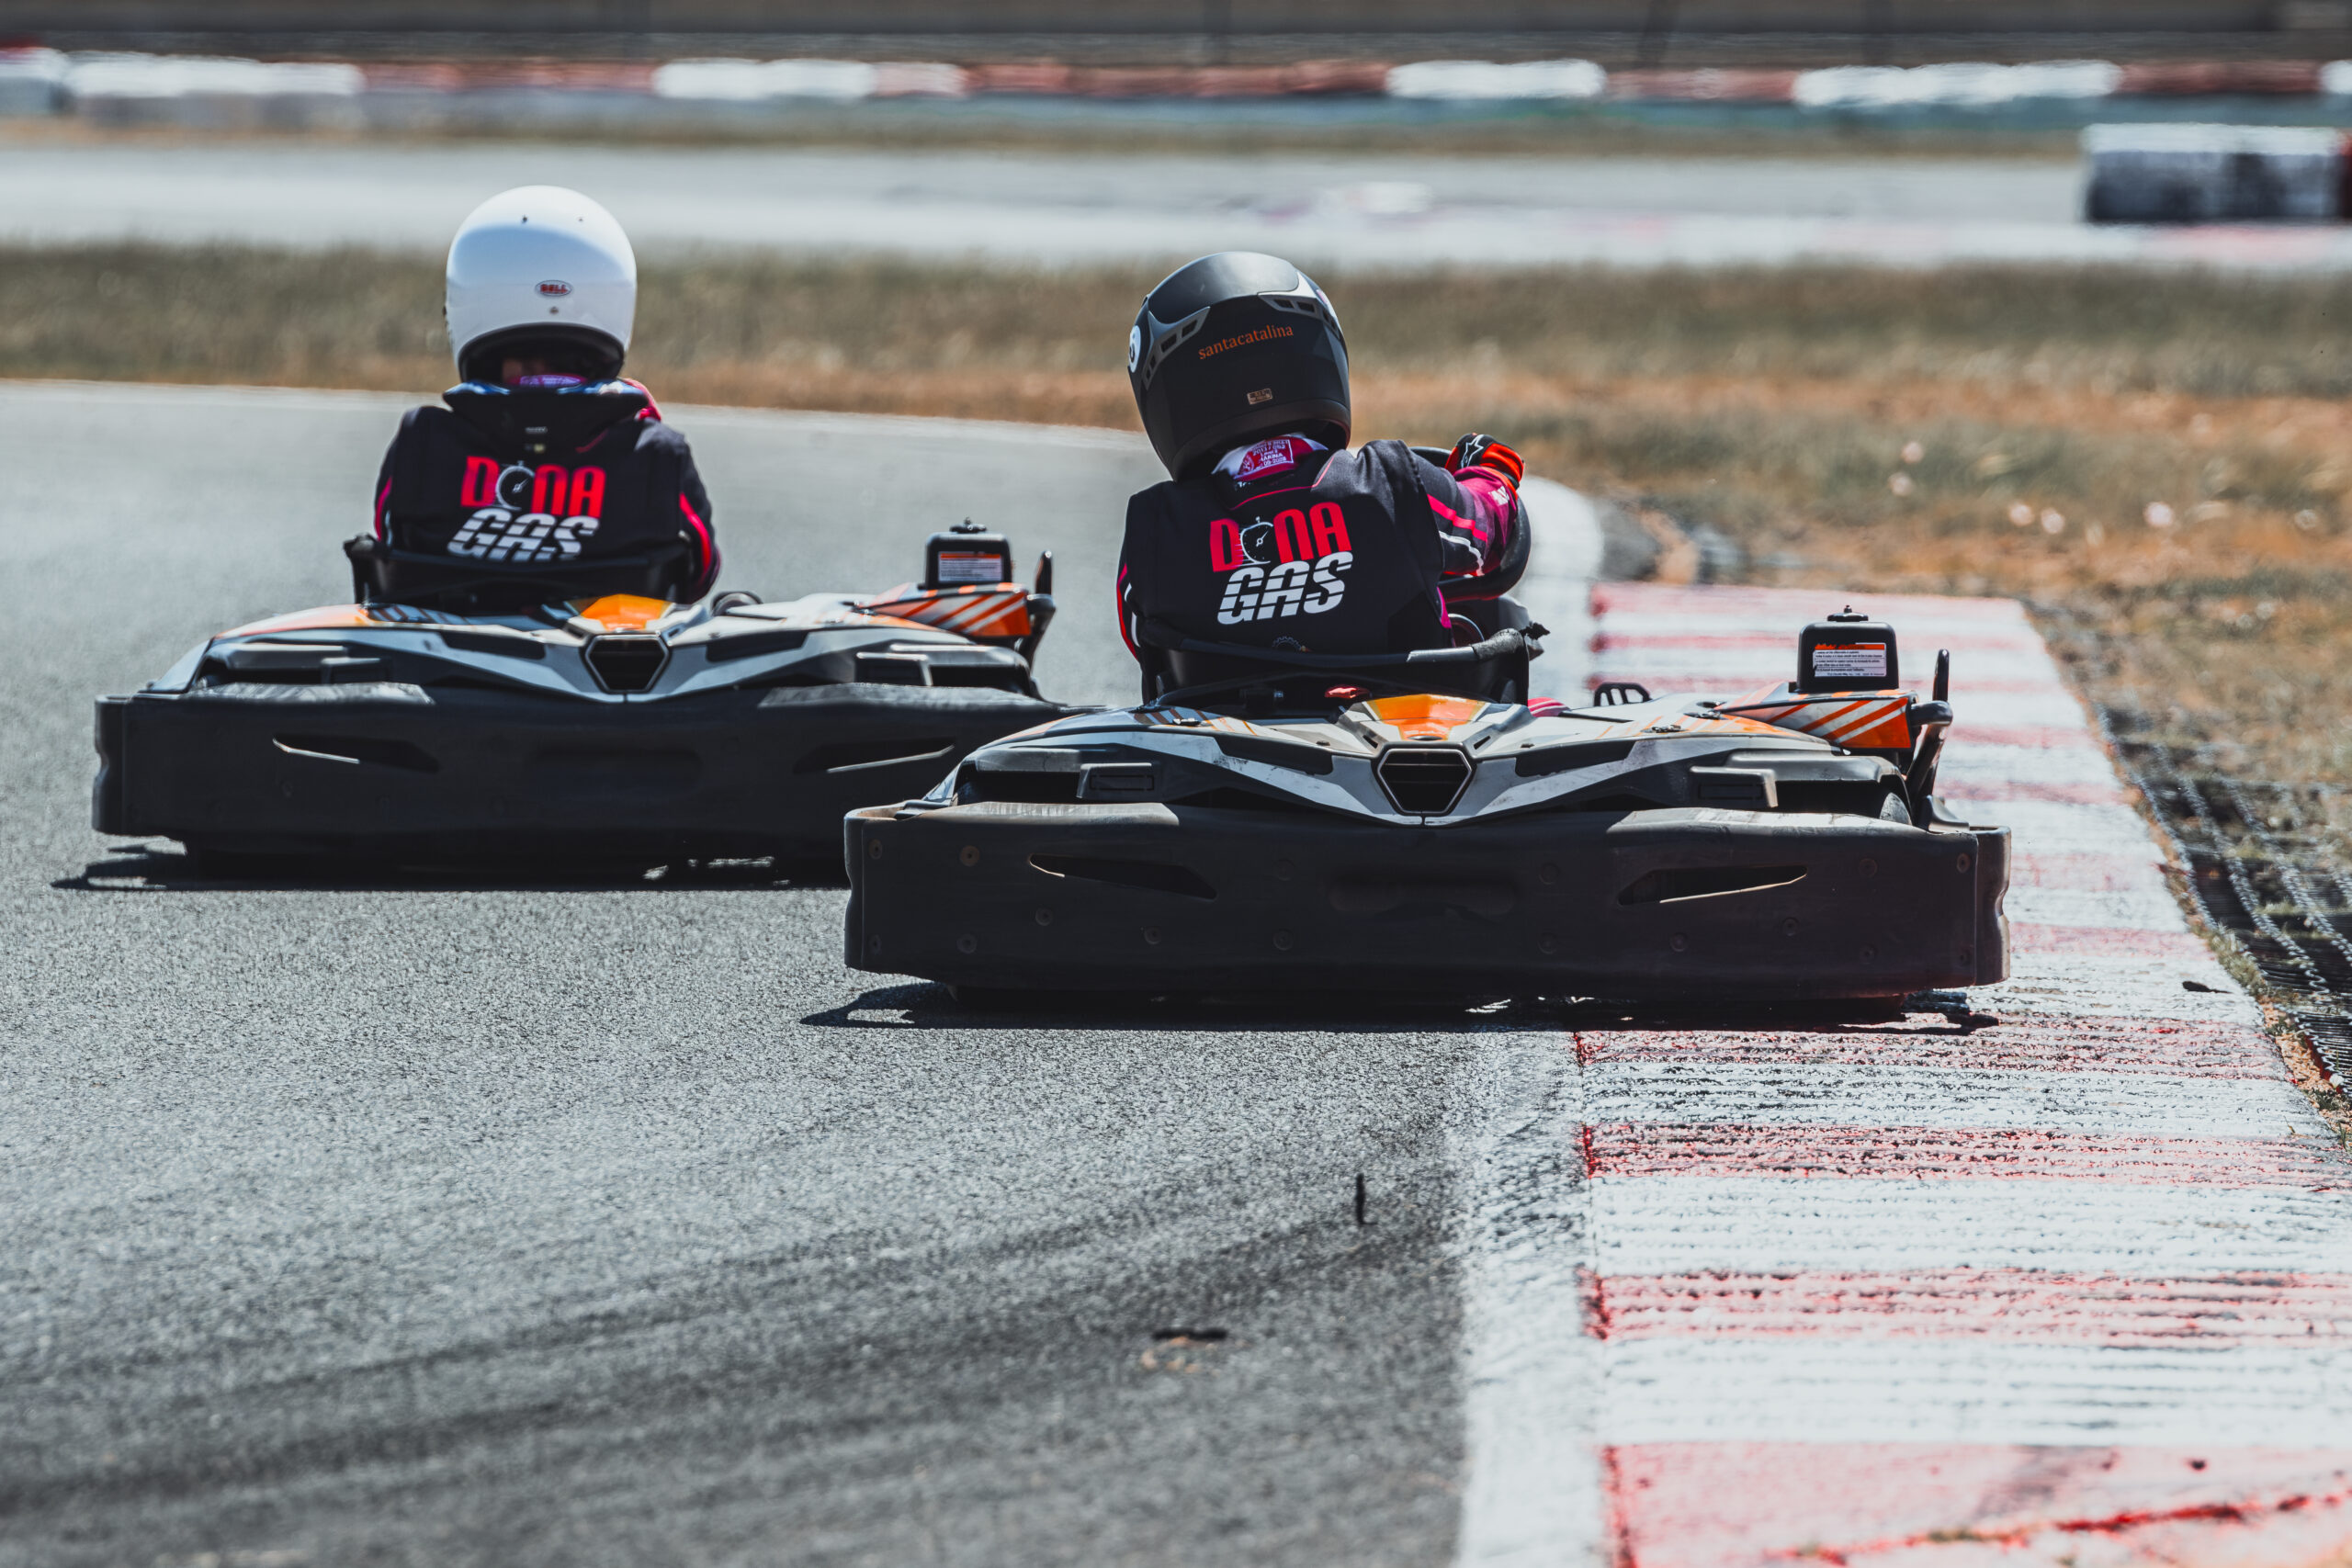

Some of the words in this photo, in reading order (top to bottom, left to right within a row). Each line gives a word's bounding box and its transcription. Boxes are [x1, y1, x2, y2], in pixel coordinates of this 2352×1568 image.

[540, 283, 569, 294] BELL
[1198, 324, 1294, 359] santacatalina
[447, 507, 600, 562] GAS
[1217, 551, 1353, 625] GAS
